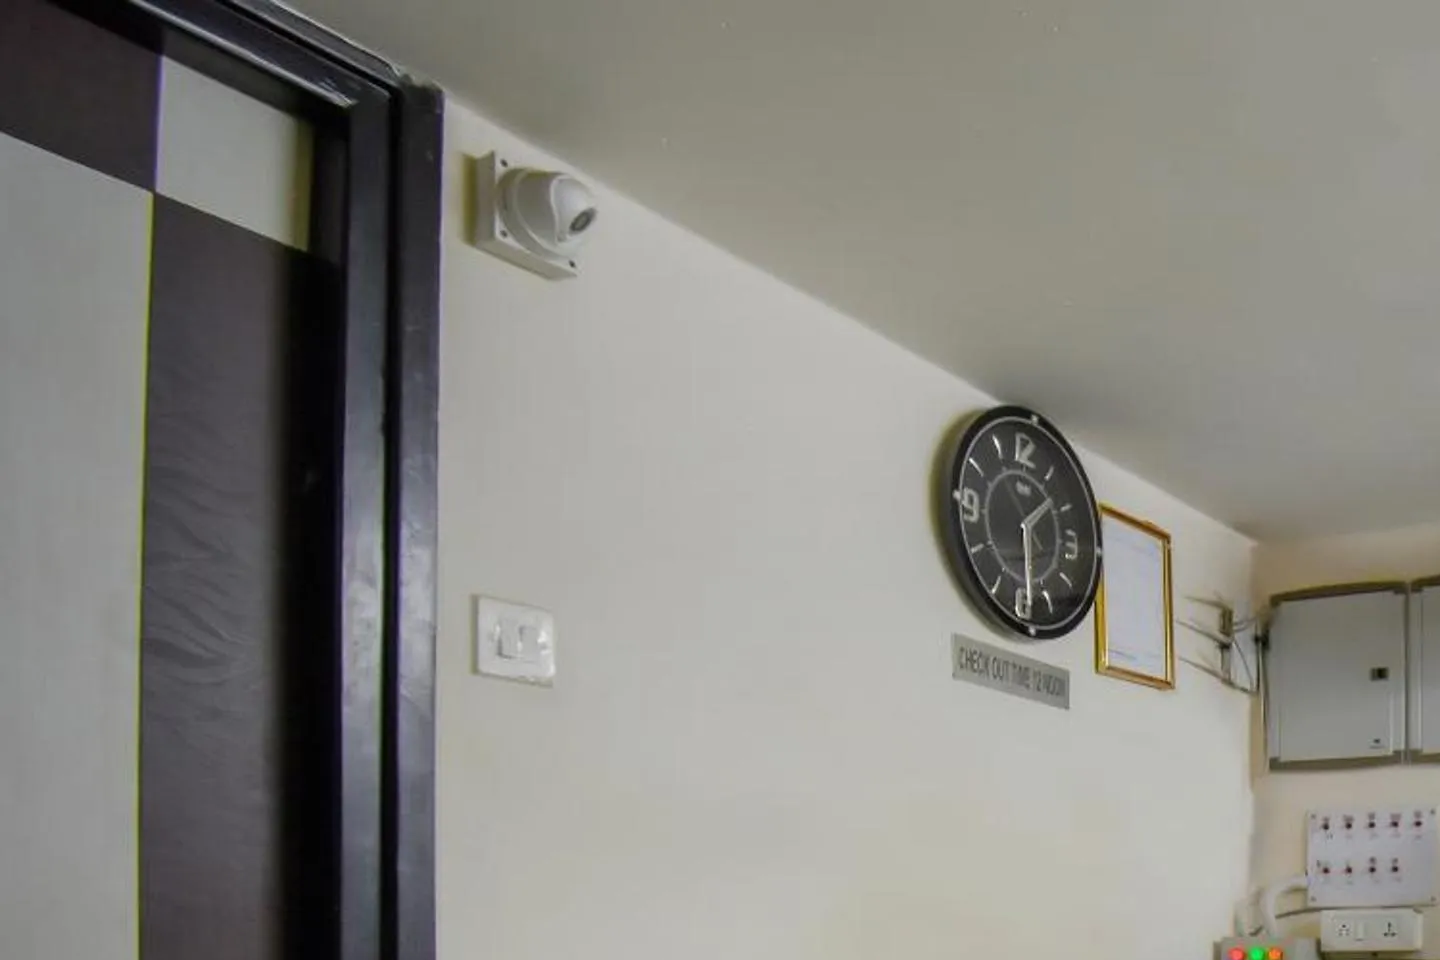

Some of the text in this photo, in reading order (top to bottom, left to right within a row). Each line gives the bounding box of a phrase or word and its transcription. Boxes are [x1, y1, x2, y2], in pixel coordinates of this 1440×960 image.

[1064, 529, 1078, 560] 3
[959, 646, 990, 678] CHECK
[991, 656, 1010, 685] OUT
